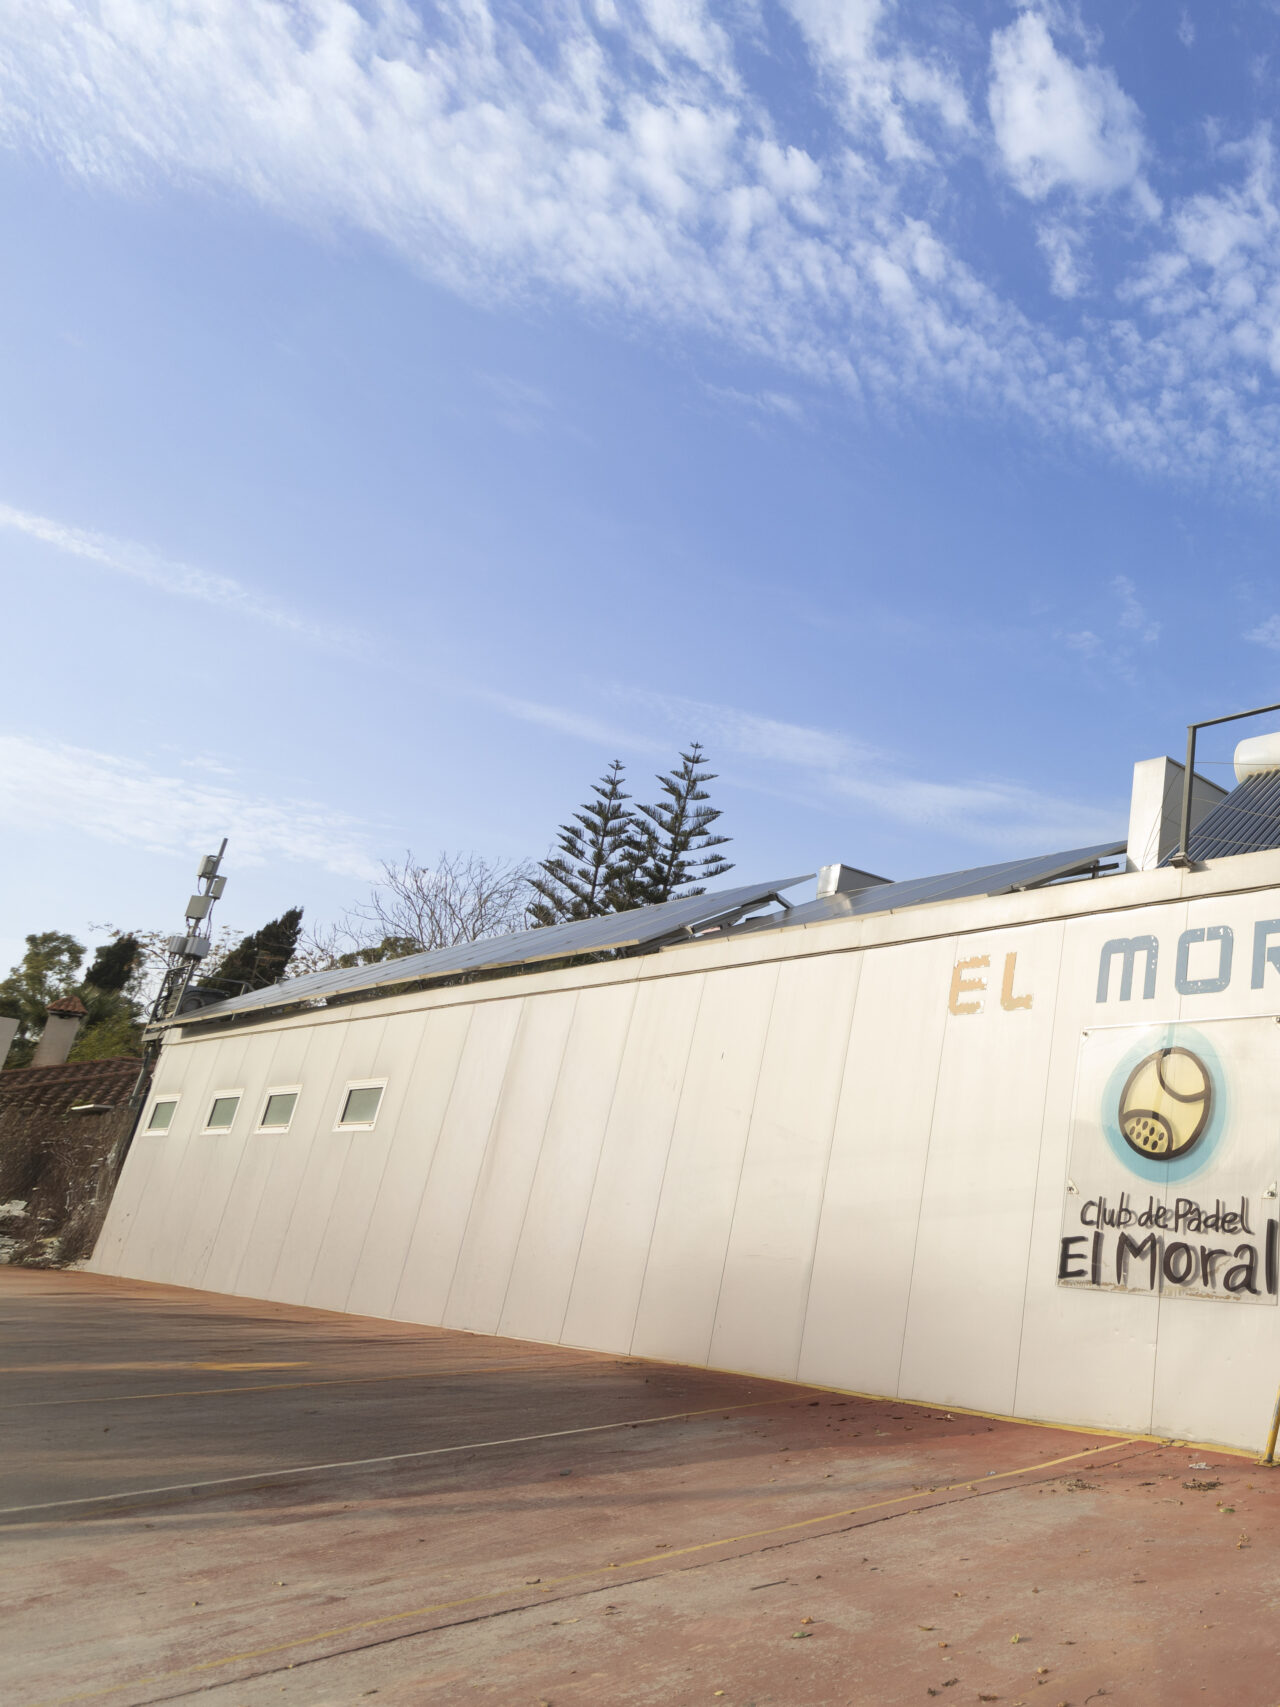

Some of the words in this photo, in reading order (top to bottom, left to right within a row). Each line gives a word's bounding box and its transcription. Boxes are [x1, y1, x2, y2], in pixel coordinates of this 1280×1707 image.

[949, 951, 1033, 1017] EL
[1080, 1191, 1132, 1230] Club
[1137, 1195, 1169, 1229] de
[1174, 1195, 1255, 1236] Padel
[1058, 1230, 1102, 1286] El
[1115, 1218, 1278, 1296] Moral
